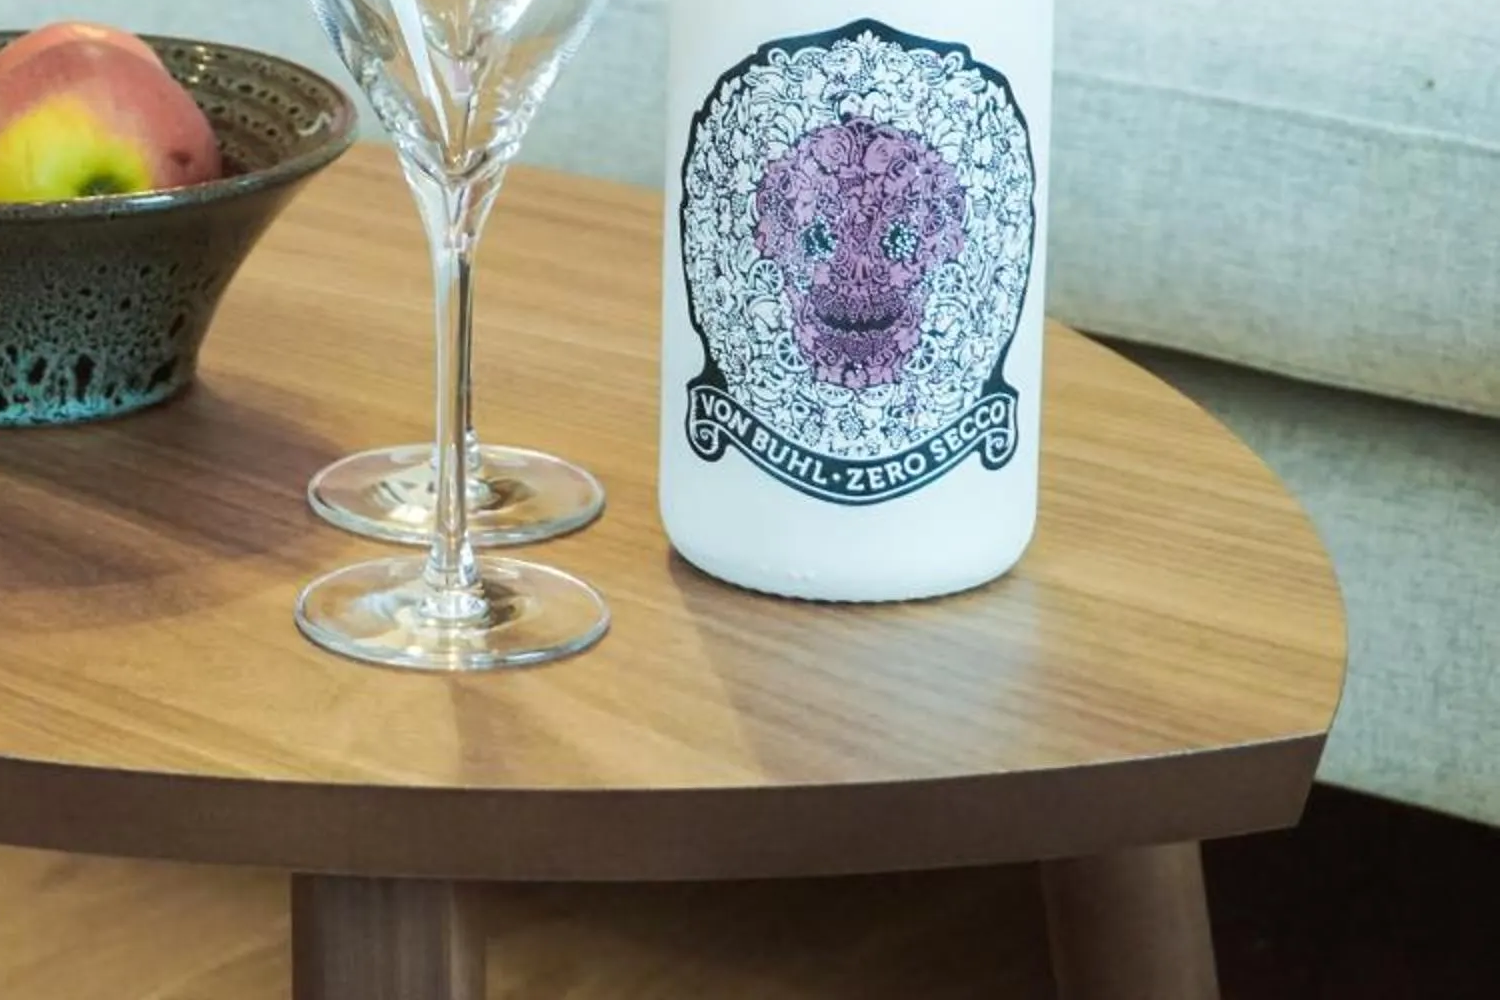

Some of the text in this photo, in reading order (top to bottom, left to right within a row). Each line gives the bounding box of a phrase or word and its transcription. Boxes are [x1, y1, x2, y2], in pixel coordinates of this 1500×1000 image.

[700, 393, 1006, 491] VON BUHL ZERO SECCO
